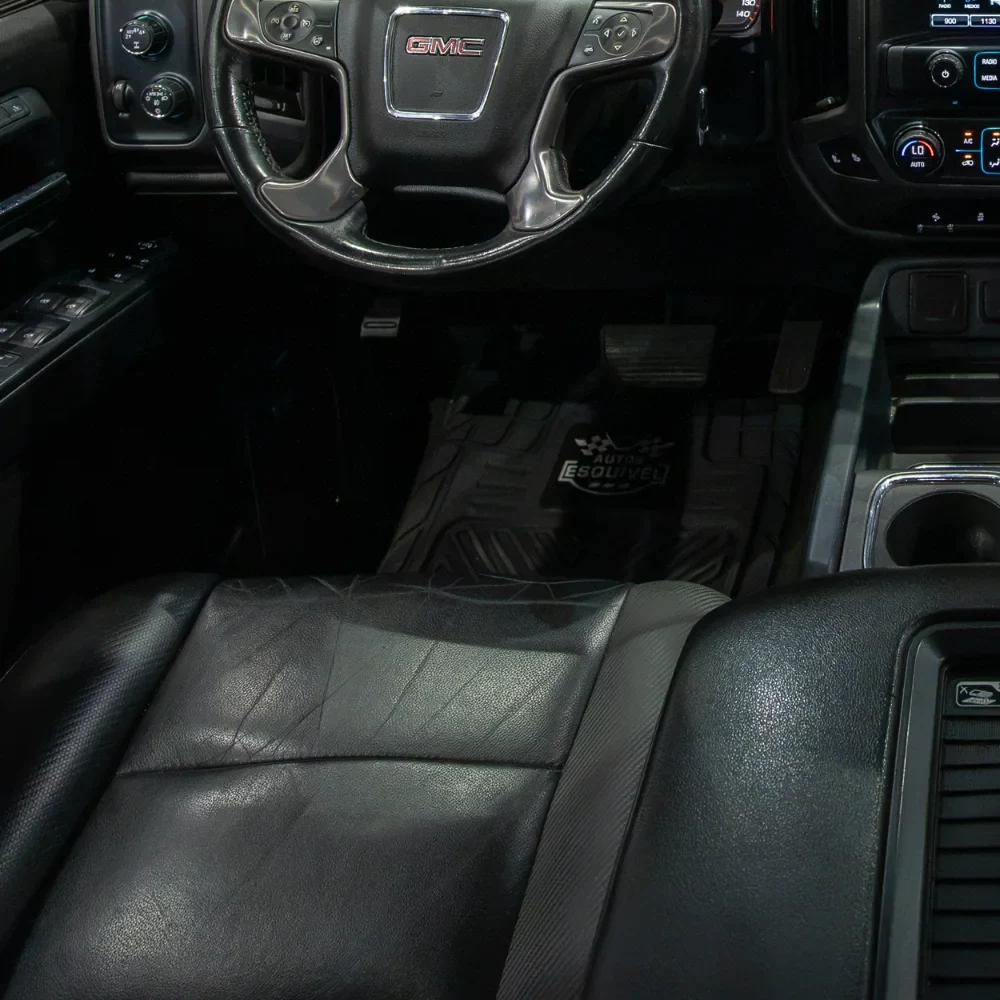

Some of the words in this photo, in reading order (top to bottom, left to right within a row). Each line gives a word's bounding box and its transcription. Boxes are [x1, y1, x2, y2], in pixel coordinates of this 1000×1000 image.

[735, 10, 751, 18] 140
[405, 35, 486, 56] GMC
[911, 146, 924, 156] LO
[563, 465, 662, 481] ESQUIVEL
